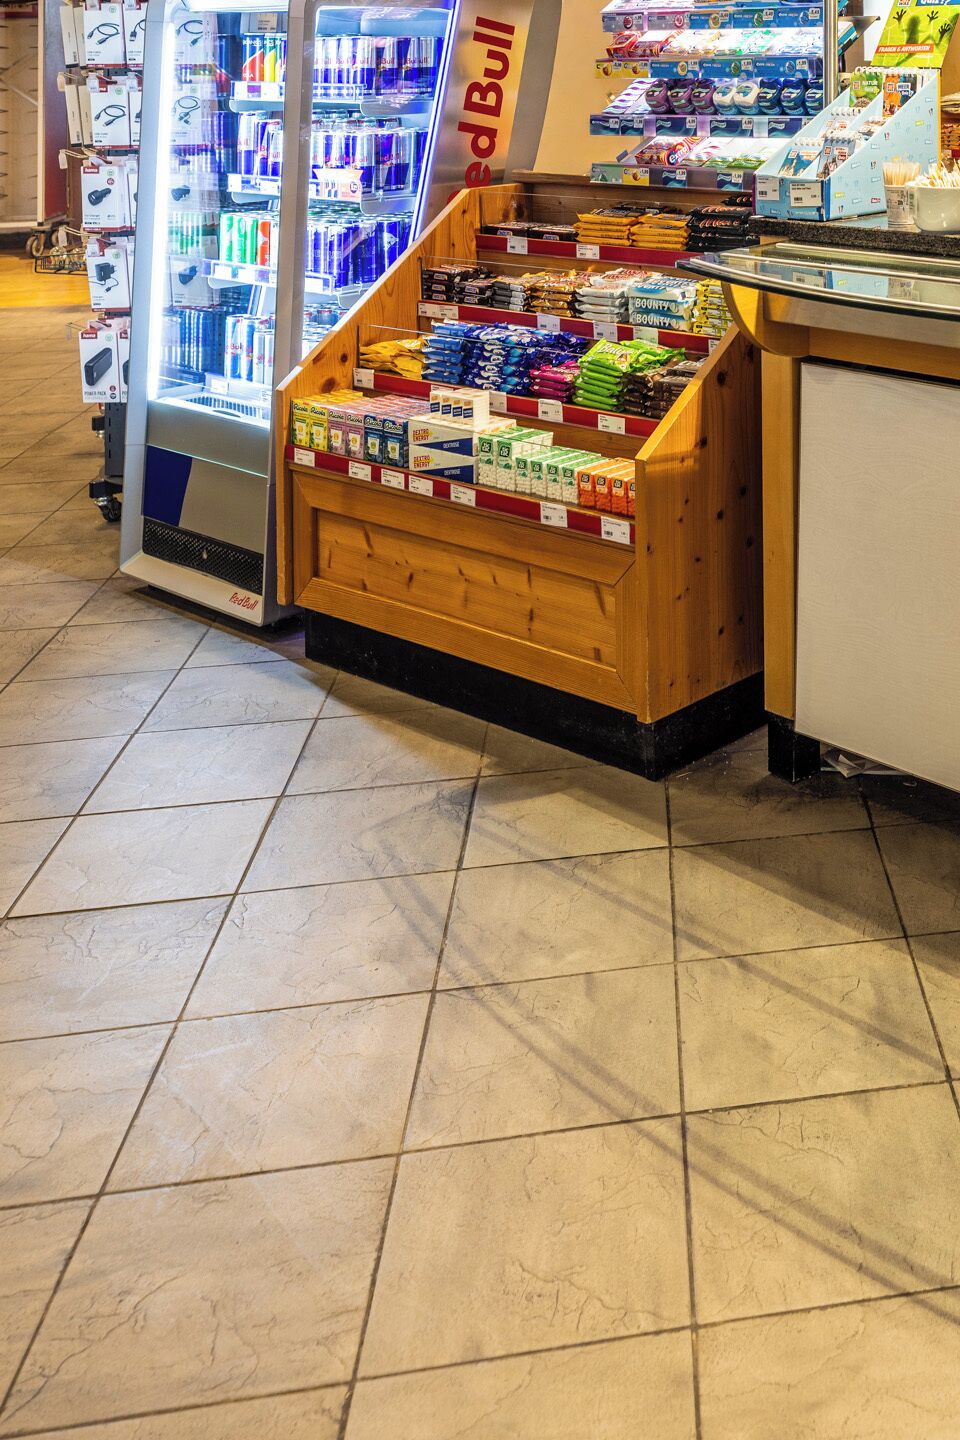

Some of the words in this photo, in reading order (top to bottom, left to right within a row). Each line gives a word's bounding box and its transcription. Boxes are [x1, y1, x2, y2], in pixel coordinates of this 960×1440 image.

[901, 44, 930, 52] ANTWORTEN
[463, 15, 515, 118] Bull
[447, 121, 498, 205] ed
[635, 298, 670, 311] BOUNTY
[636, 313, 670, 326] BOUNTY
[293, 403, 308, 413] Ricola
[310, 406, 326, 417] Ricola
[328, 410, 345, 421] Ricola
[346, 413, 363, 424] Ricola
[365, 417, 383, 428] Ricola
[384, 421, 403, 432] Ricola
[412, 428, 430, 436] DEXTRO
[412, 434, 429, 442] ENERGY
[413, 461, 430, 469] ENERGY
[228, 592, 244, 606] Red
[242, 596, 258, 611] Bull
